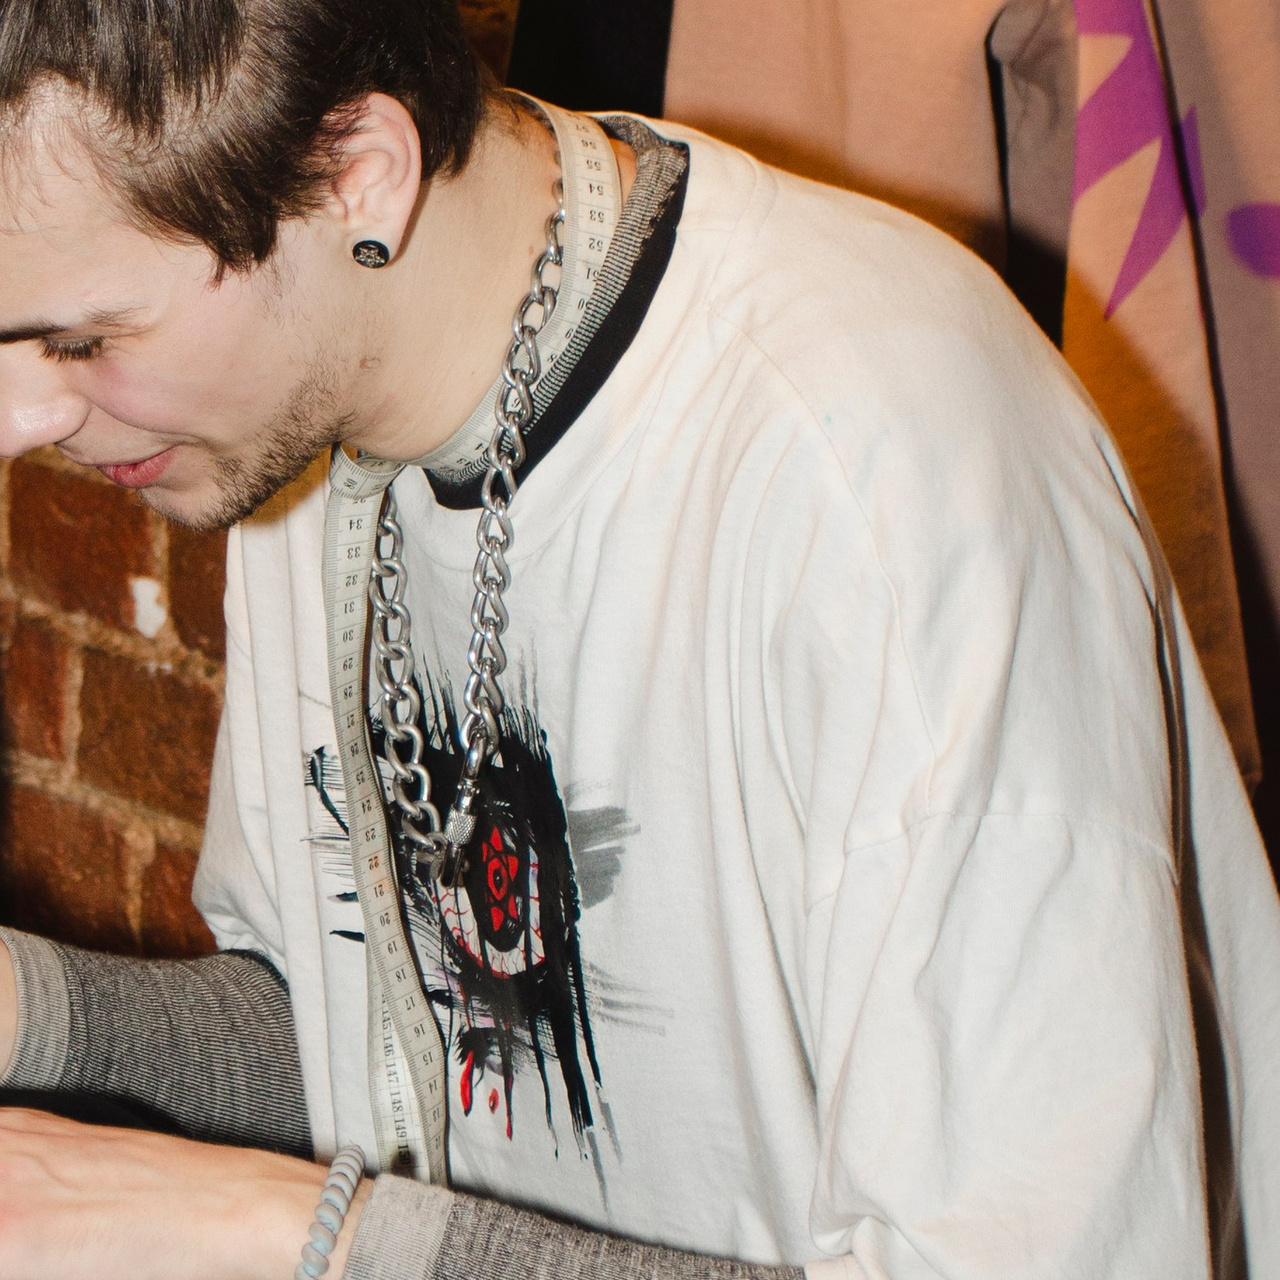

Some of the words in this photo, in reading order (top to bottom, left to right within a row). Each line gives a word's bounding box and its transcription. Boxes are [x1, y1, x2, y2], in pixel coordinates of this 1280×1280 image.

[581, 139, 597, 150] 56
[585, 159, 602, 171] 55
[588, 183, 604, 196] 54
[589, 209, 605, 223] 53
[588, 237, 604, 252] 52
[586, 268, 600, 282] 51
[348, 519, 363, 531] 34
[347, 547, 361, 559] 33
[345, 575, 358, 587] 32
[344, 602, 355, 614] 31
[342, 630, 354, 643] 30
[342, 657, 353, 671] 29
[343, 686, 353, 700] 28
[346, 714, 355, 729] 27
[350, 743, 359, 757] 26
[356, 771, 365, 785] 25
[361, 800, 372, 814] 24
[365, 827, 376, 842] 23
[368, 856, 379, 871] 22
[373, 884, 384, 898] 21
[379, 912, 391, 927] 20
[387, 940, 398, 955] 19
[395, 968, 407, 983] 18
[404, 996, 416, 1011] 17
[414, 1024, 426, 1038] 16
[383, 1034, 395, 1057] 146
[422, 1051, 433, 1066] 15
[385, 1062, 399, 1083] 147
[428, 1080, 438, 1094] 14
[389, 1091, 403, 1113] 148
[432, 1108, 440, 1122] 13
[394, 1117, 407, 1138] 149
